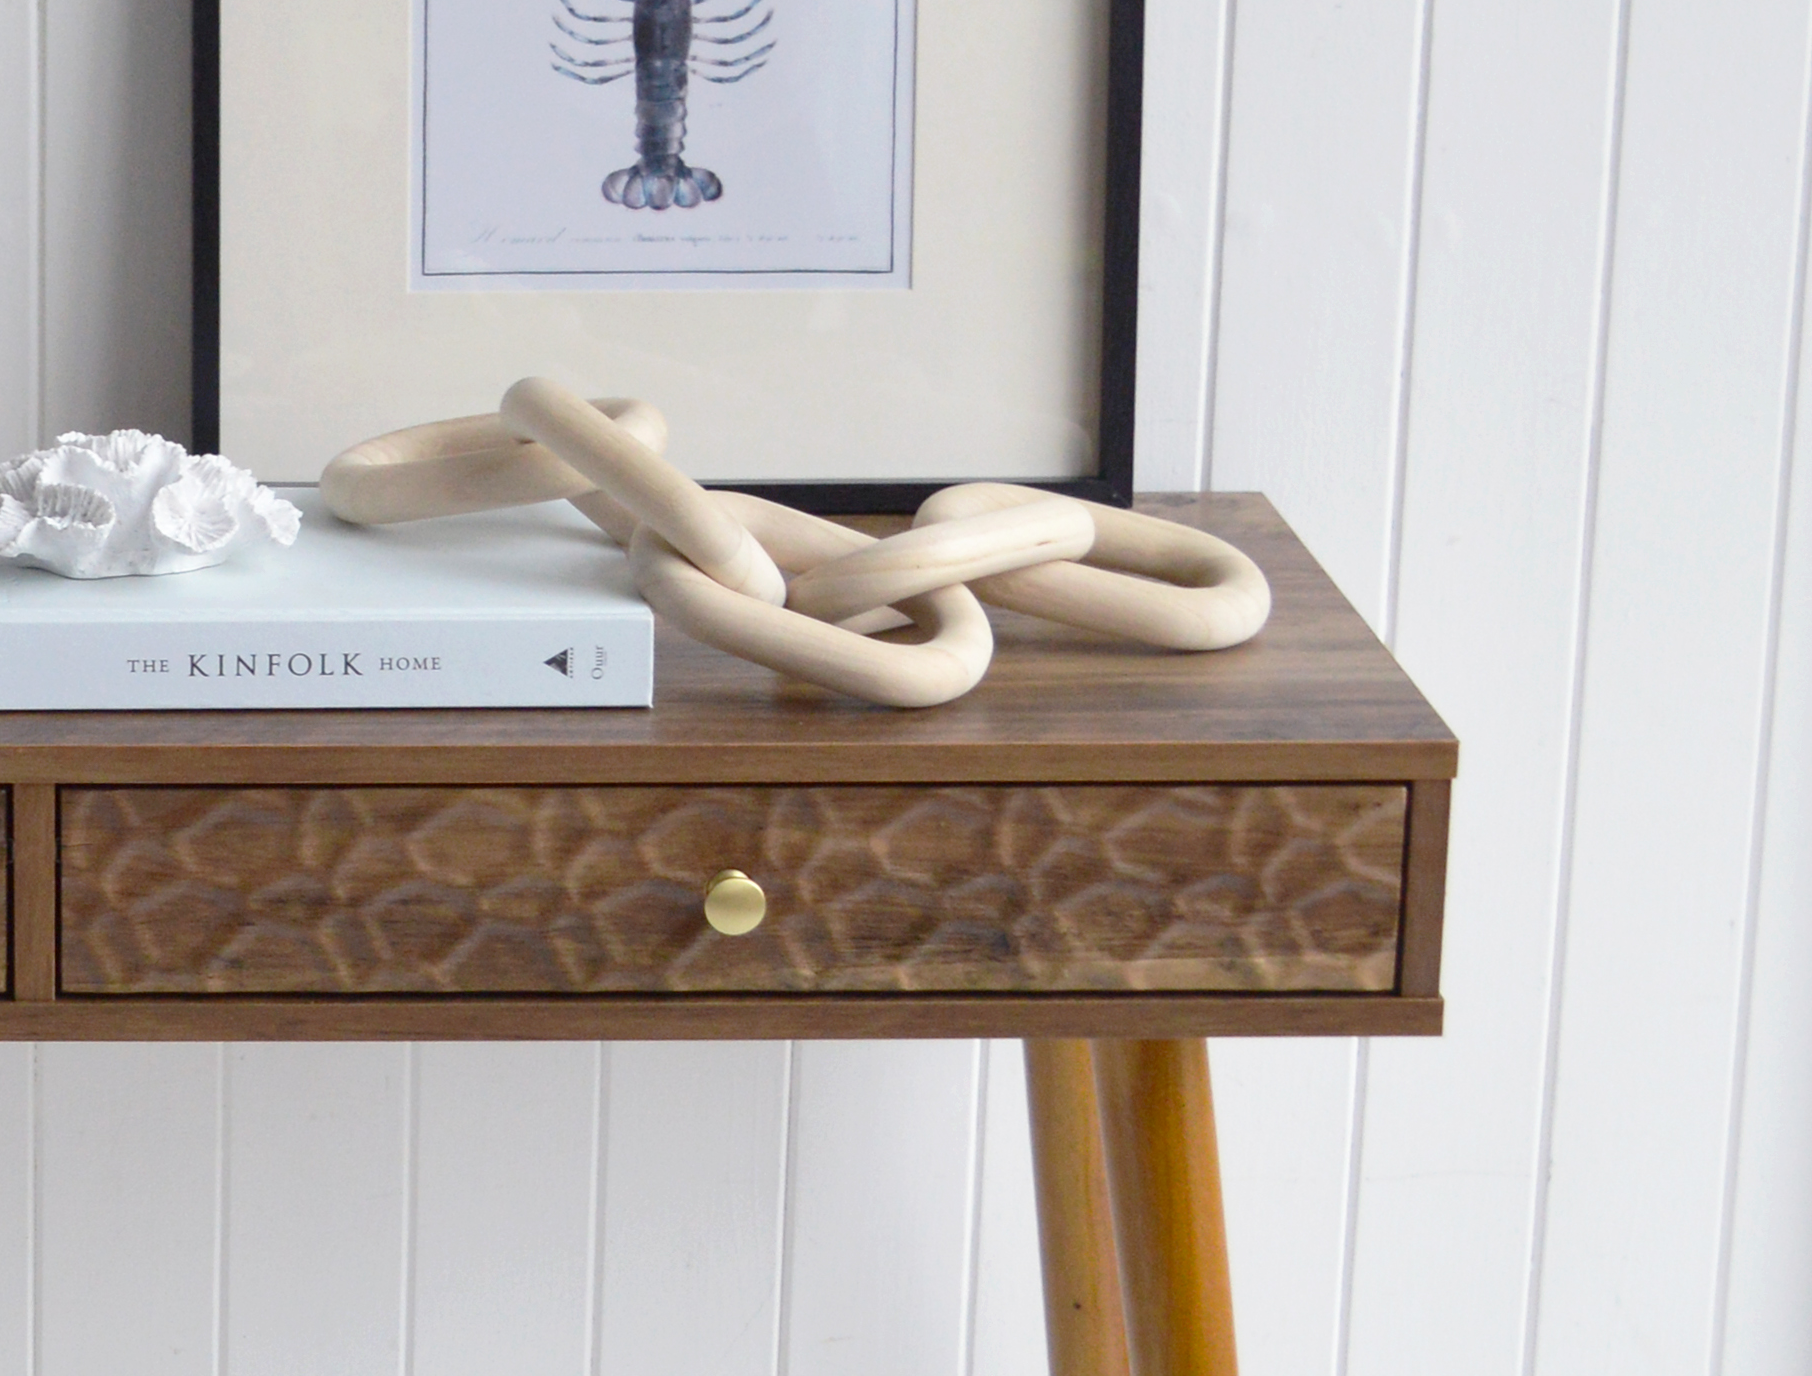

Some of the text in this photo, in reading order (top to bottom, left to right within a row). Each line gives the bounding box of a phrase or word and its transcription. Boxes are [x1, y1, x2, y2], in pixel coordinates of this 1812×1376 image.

[126, 653, 442, 677] THE KINFOLK HOME
